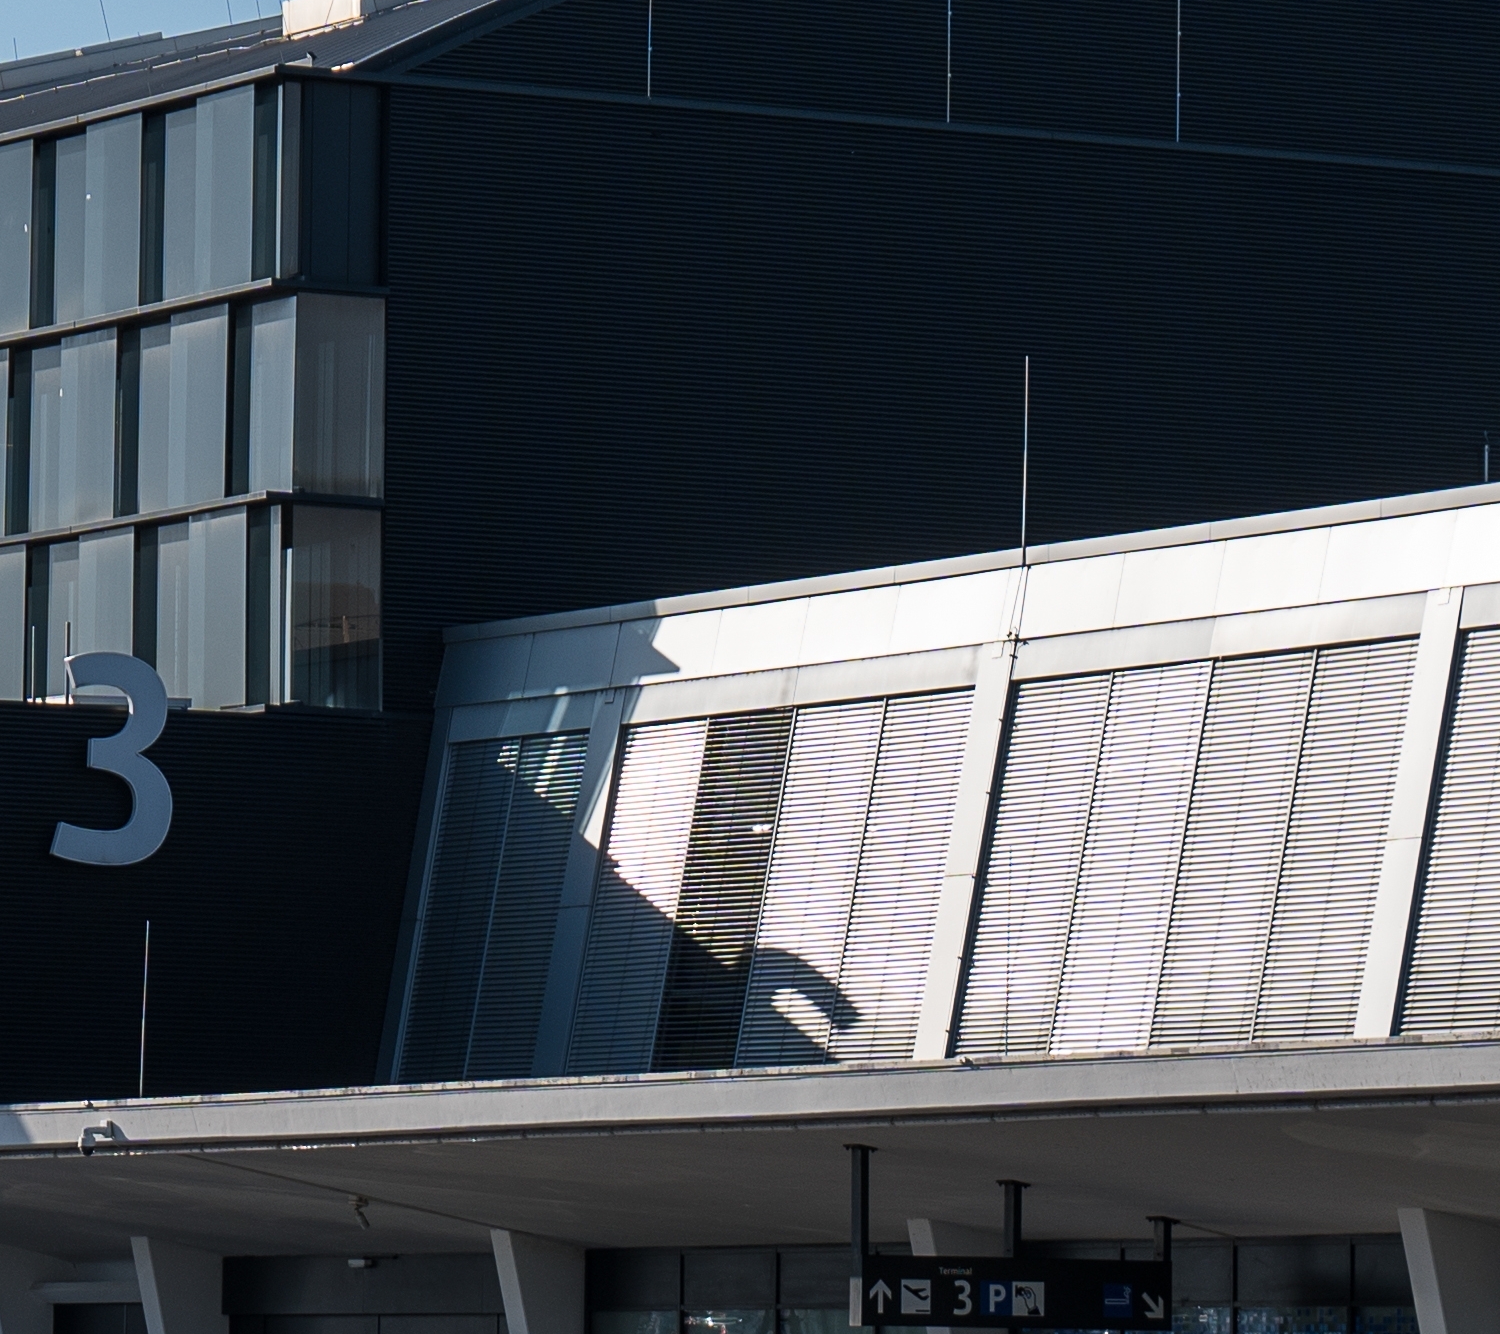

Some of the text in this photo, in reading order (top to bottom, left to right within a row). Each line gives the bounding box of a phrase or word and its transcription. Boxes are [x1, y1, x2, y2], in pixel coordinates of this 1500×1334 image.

[48, 651, 174, 867] 3
[938, 1266, 973, 1275] Terminal
[952, 1279, 1007, 1316] 3 P
